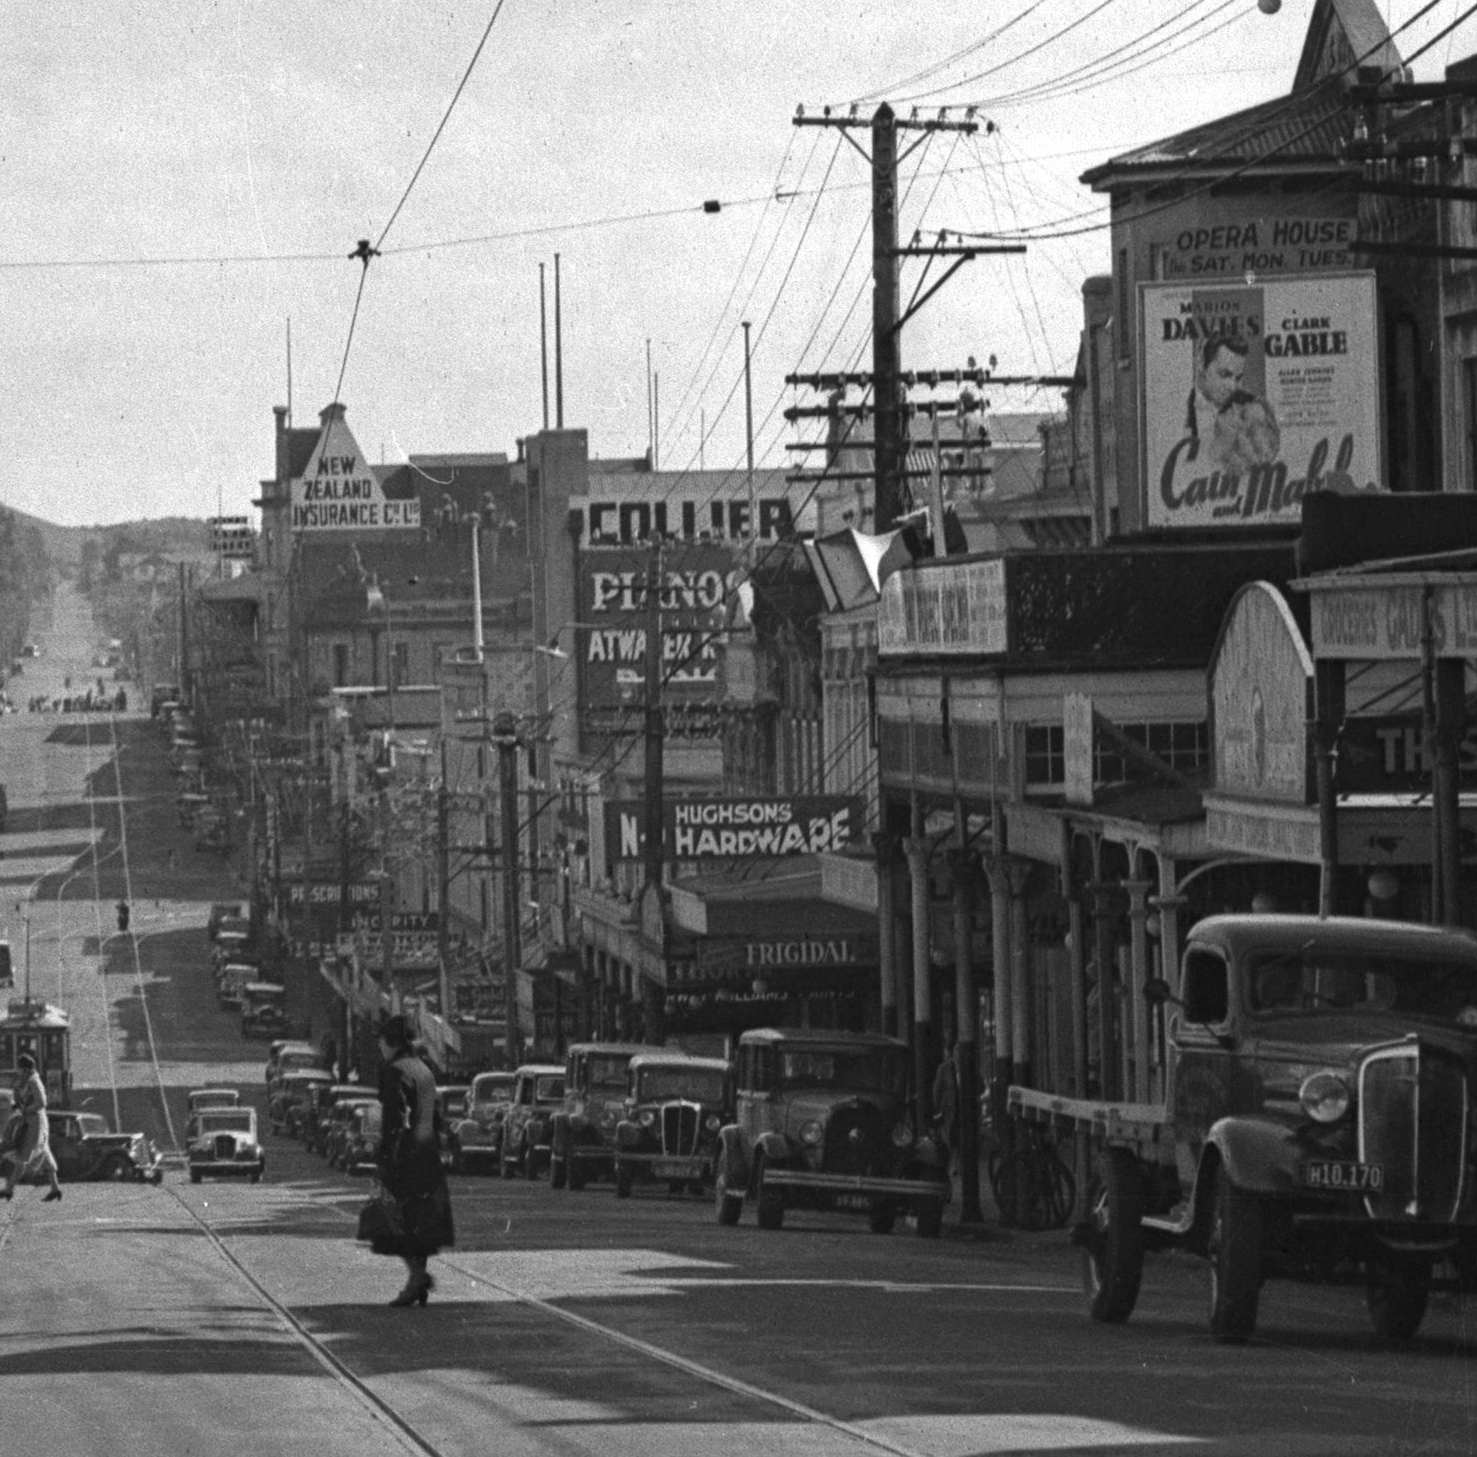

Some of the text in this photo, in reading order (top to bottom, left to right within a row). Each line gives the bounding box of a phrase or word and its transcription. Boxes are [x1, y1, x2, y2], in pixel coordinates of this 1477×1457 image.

[1177, 220, 1349, 252] OPERA HOUSE
[1281, 316, 1331, 331] CLARK
[1161, 314, 1348, 358] DAVIES GABLE
[318, 455, 357, 477] NEW
[1240, 432, 1354, 520] Mabl
[304, 479, 372, 501] ZEALAND
[293, 503, 378, 527] INSURANCE
[673, 801, 792, 825] HUGHSONS
[673, 807, 850, 857] HARDWARE
